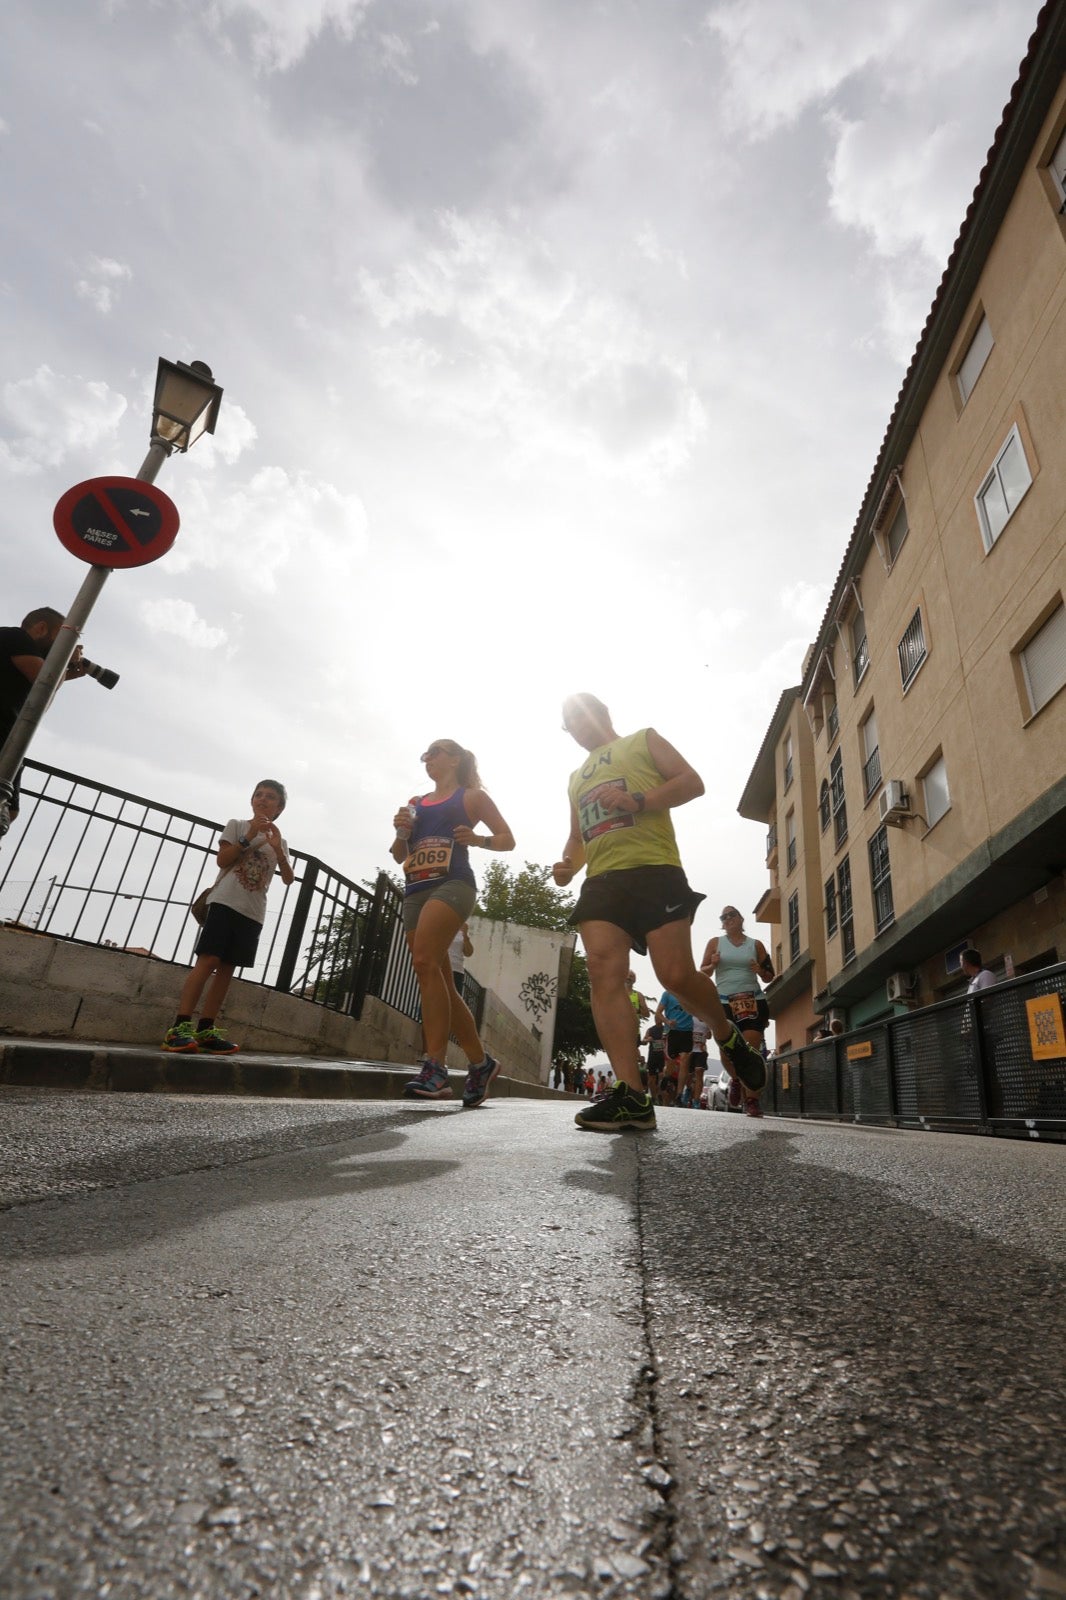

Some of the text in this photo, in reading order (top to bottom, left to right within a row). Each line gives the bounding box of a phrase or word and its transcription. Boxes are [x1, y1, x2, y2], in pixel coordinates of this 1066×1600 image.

[83, 534, 112, 546] PARES
[87, 527, 118, 540] MESES
[408, 850, 447, 868] 2069
